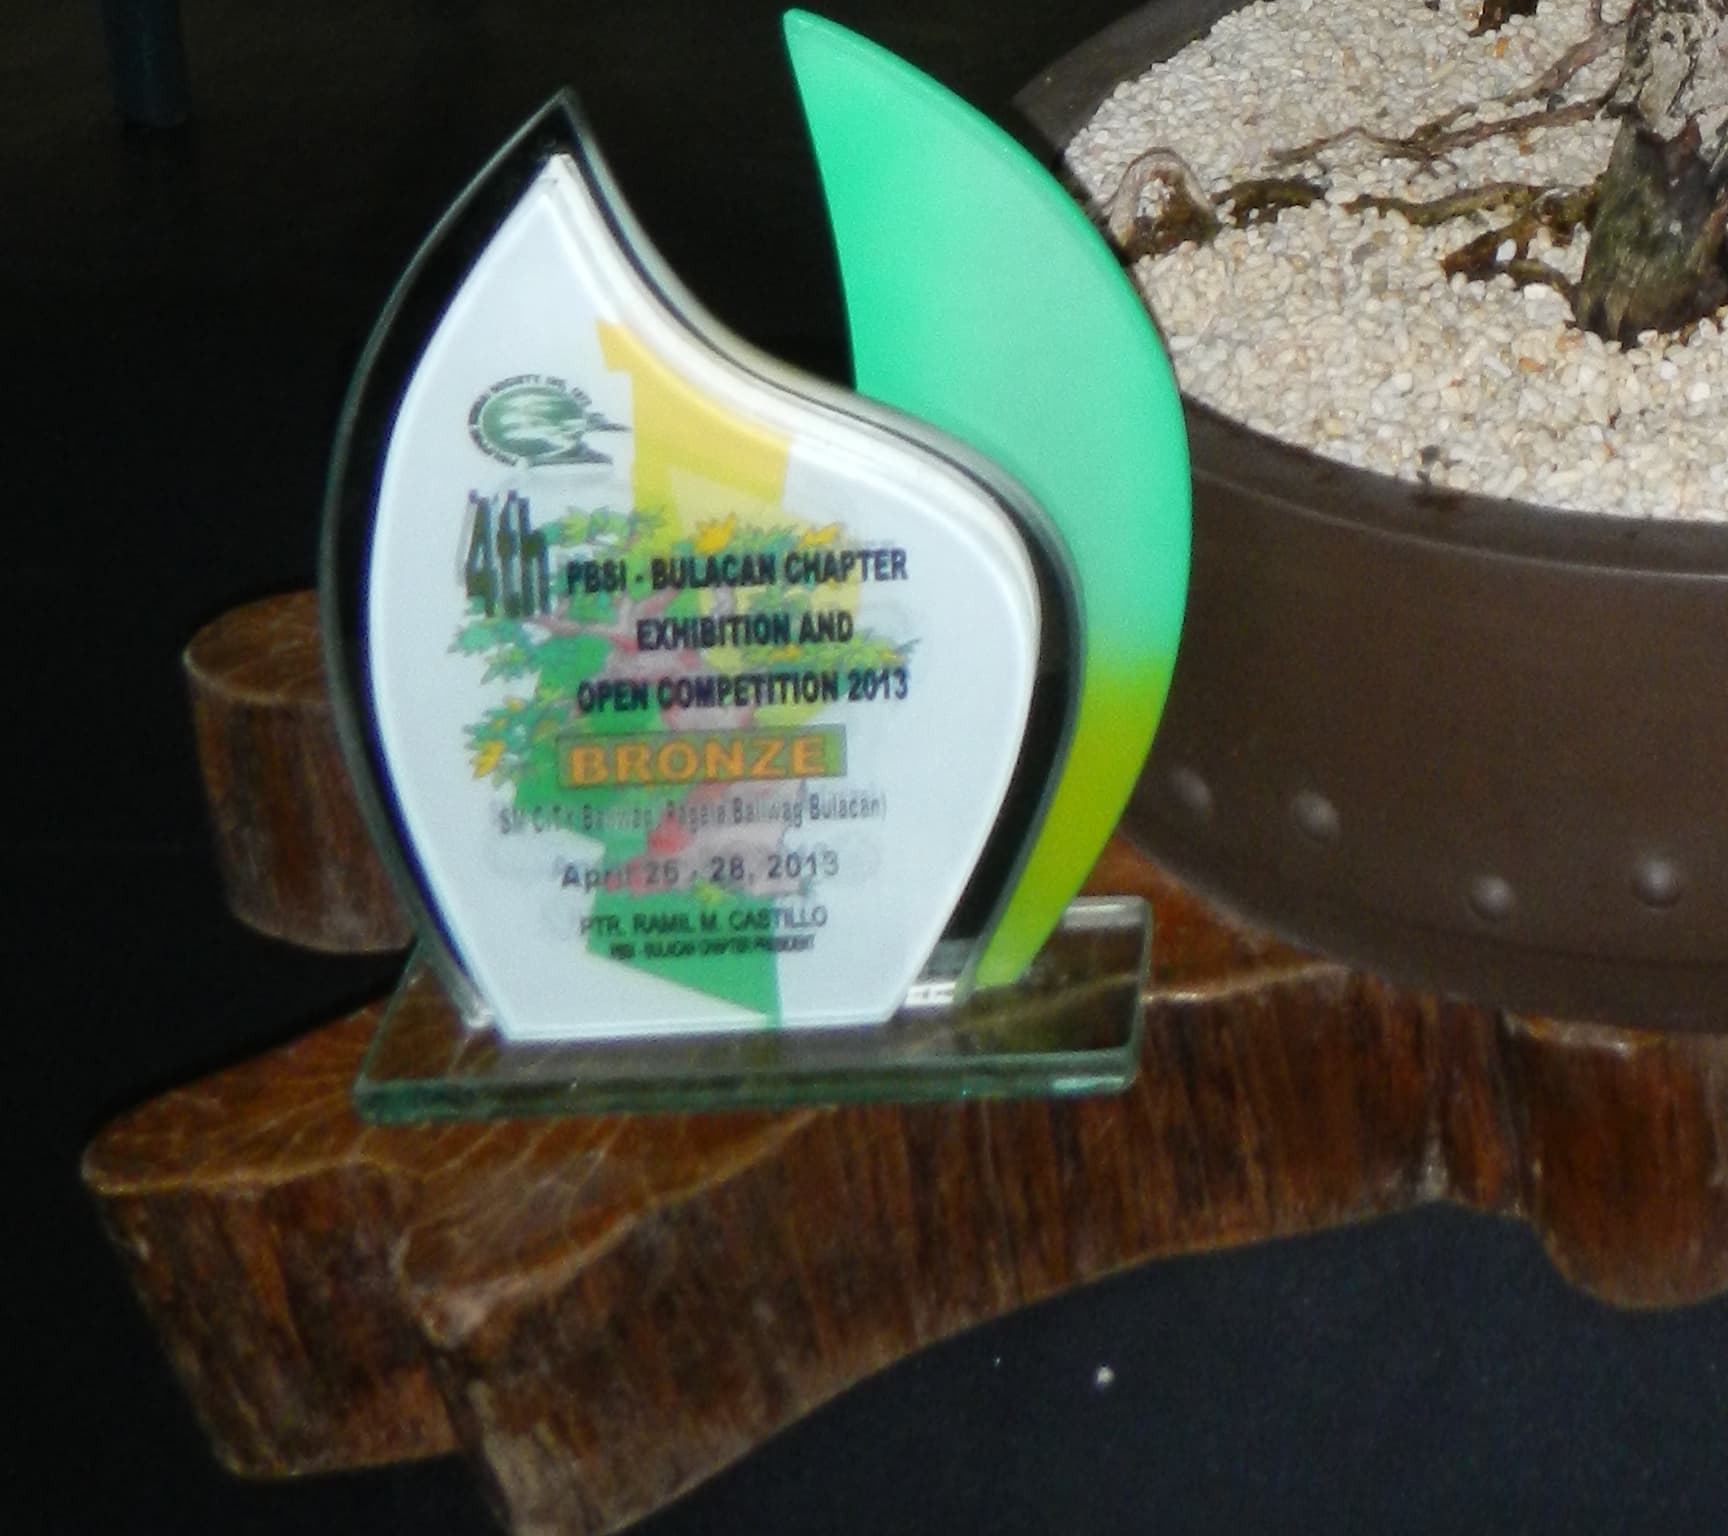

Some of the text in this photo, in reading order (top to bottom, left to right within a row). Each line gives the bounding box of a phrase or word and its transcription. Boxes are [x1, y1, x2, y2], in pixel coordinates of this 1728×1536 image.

[464, 489, 551, 616] 4th
[566, 558, 627, 595] PBSI
[650, 552, 777, 592] BULACAN
[784, 548, 909, 586] CHAPTER
[636, 609, 854, 651] EXHIBITION AND
[576, 666, 910, 713] OPEN COMPETITION 2013
[568, 734, 827, 786] BRONZE
[561, 863, 630, 893] April
[767, 850, 840, 879] 2013
[728, 905, 829, 931] CASTILLO
